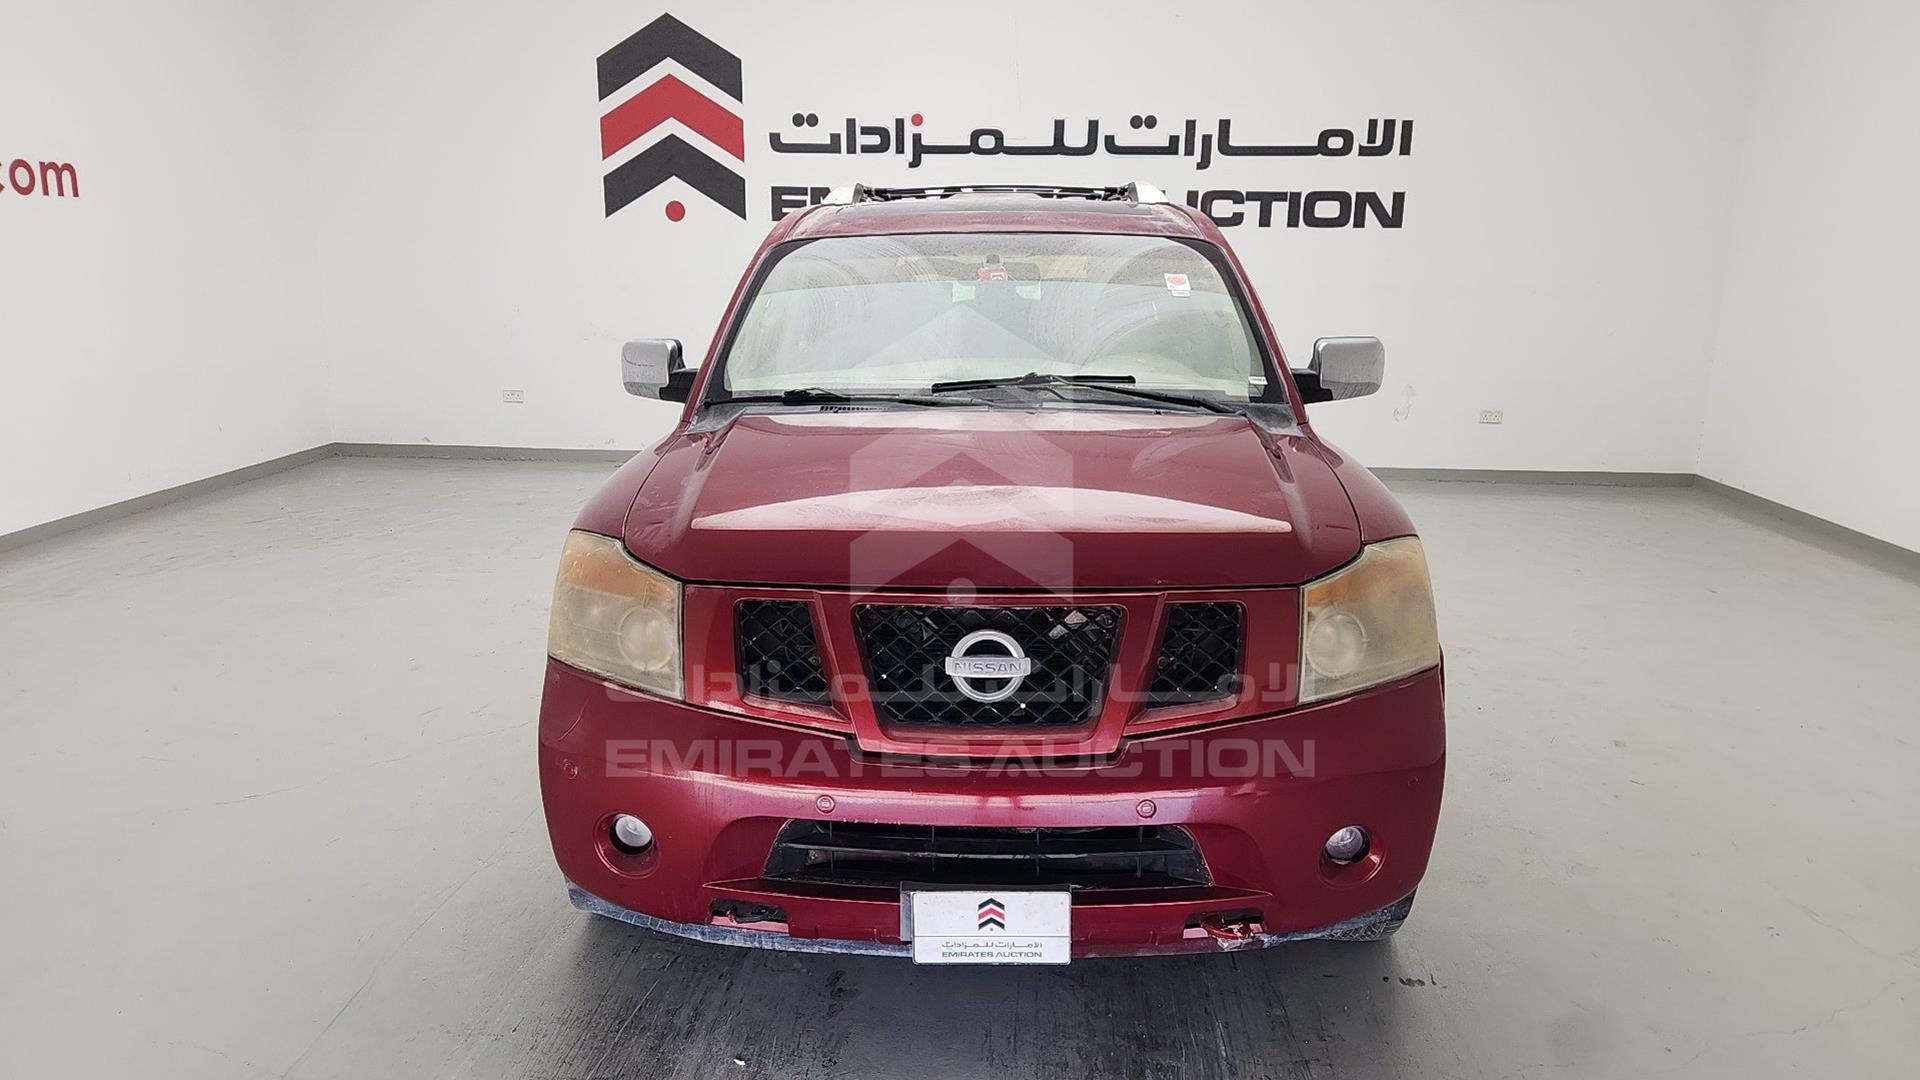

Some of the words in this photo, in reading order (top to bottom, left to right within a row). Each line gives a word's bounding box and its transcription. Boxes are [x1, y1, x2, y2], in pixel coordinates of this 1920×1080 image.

[769, 113, 1099, 168] للمزادات
[0, 158, 79, 198] om
[1163, 189, 1406, 229] CTION
[954, 662, 1021, 673] NISSAN
